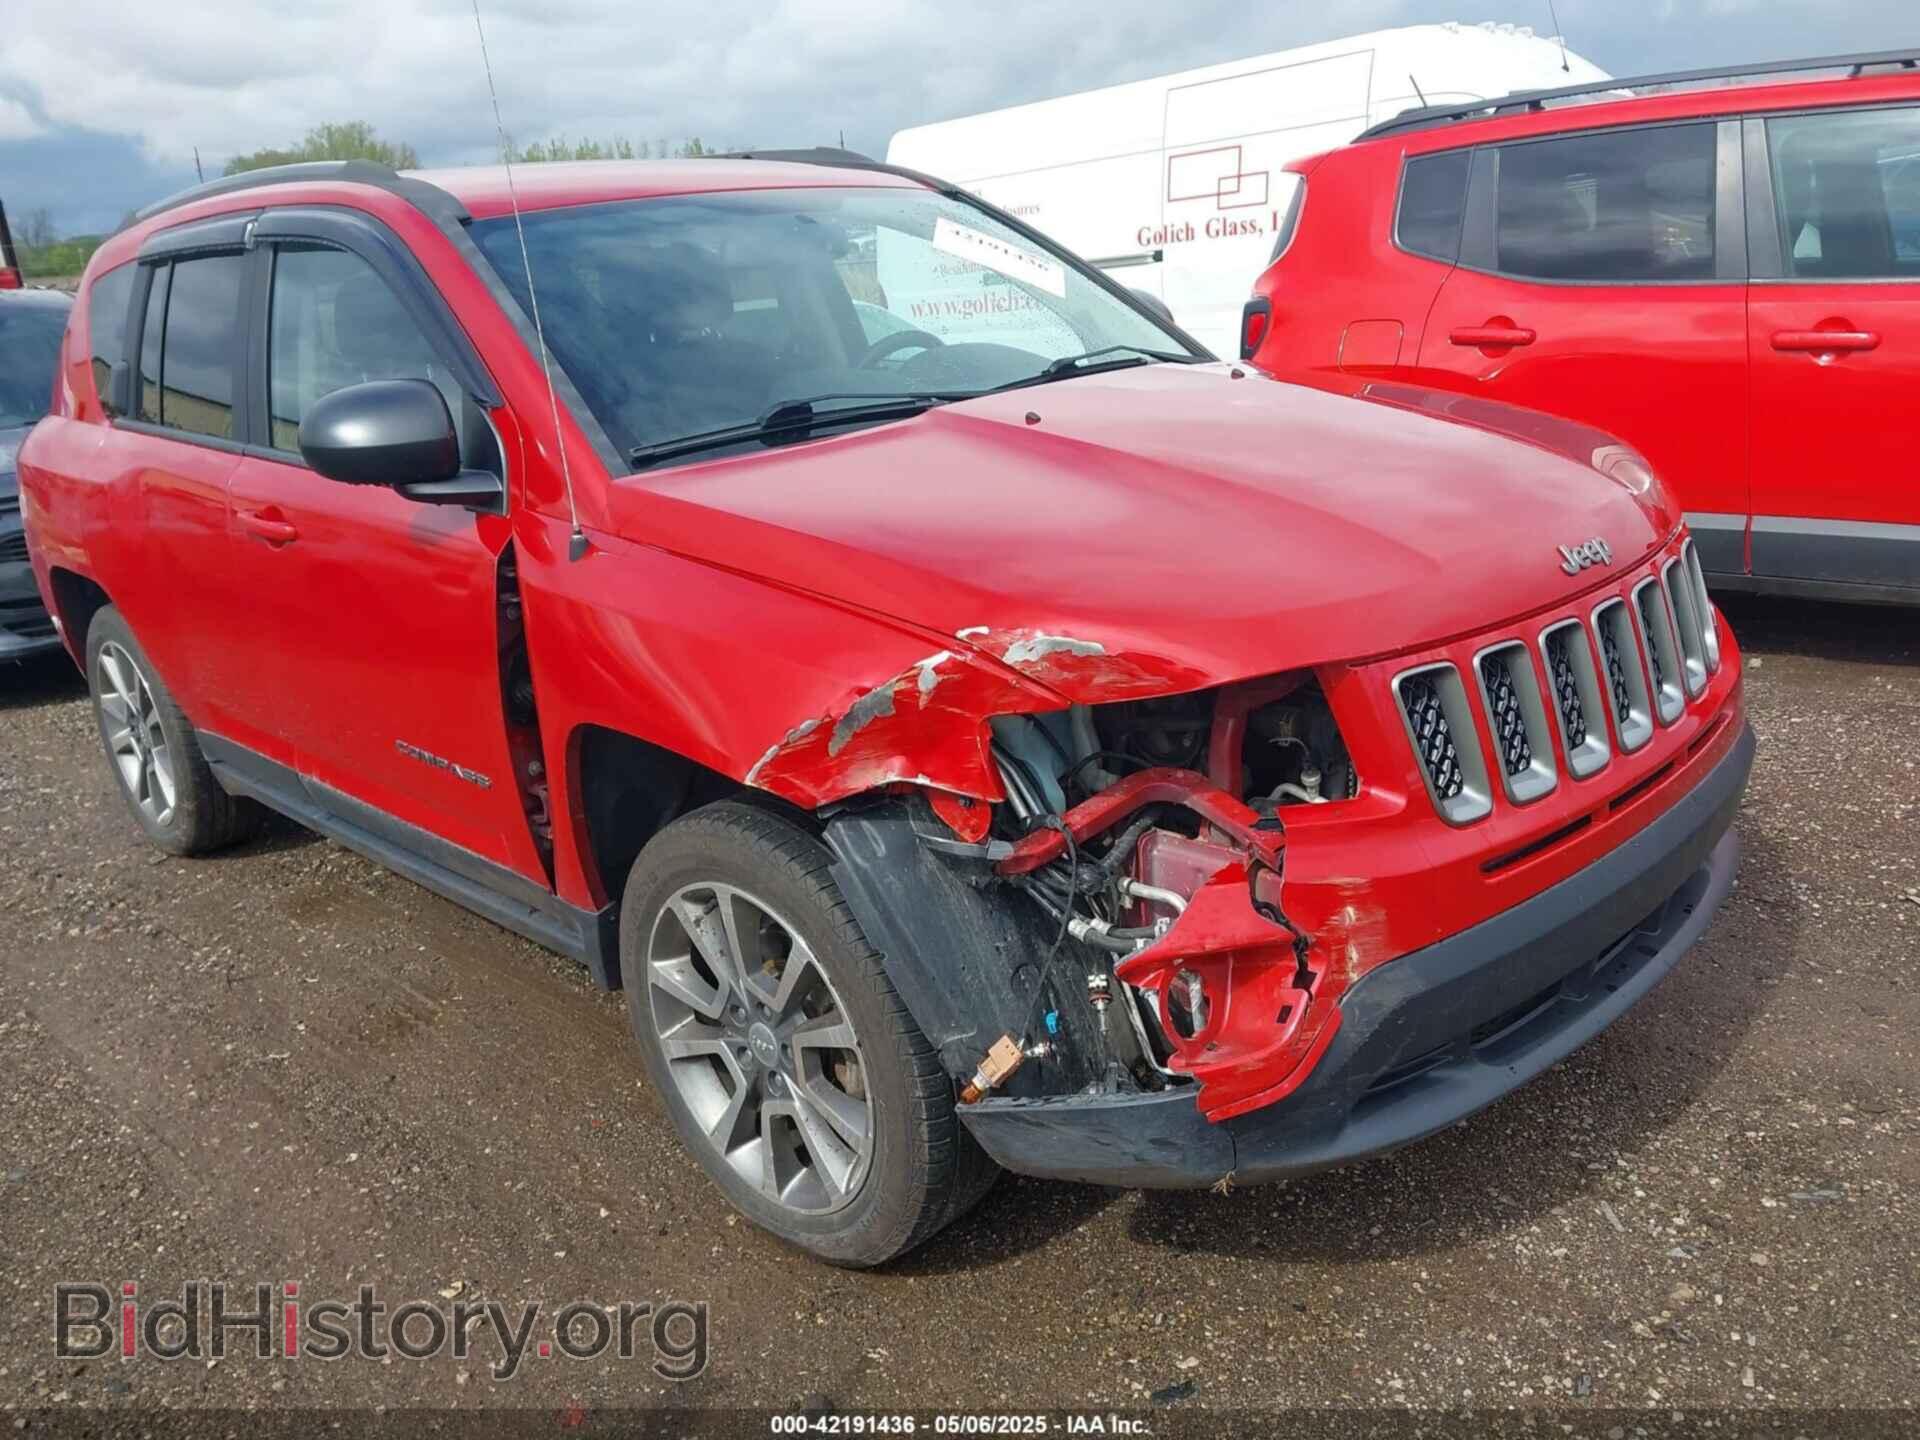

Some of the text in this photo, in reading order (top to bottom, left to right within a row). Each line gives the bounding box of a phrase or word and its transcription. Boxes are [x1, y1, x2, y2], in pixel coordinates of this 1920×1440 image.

[1136, 222, 1195, 247] Golich
[1205, 216, 1264, 239] Glass,
[1556, 536, 1613, 576] Jeep
